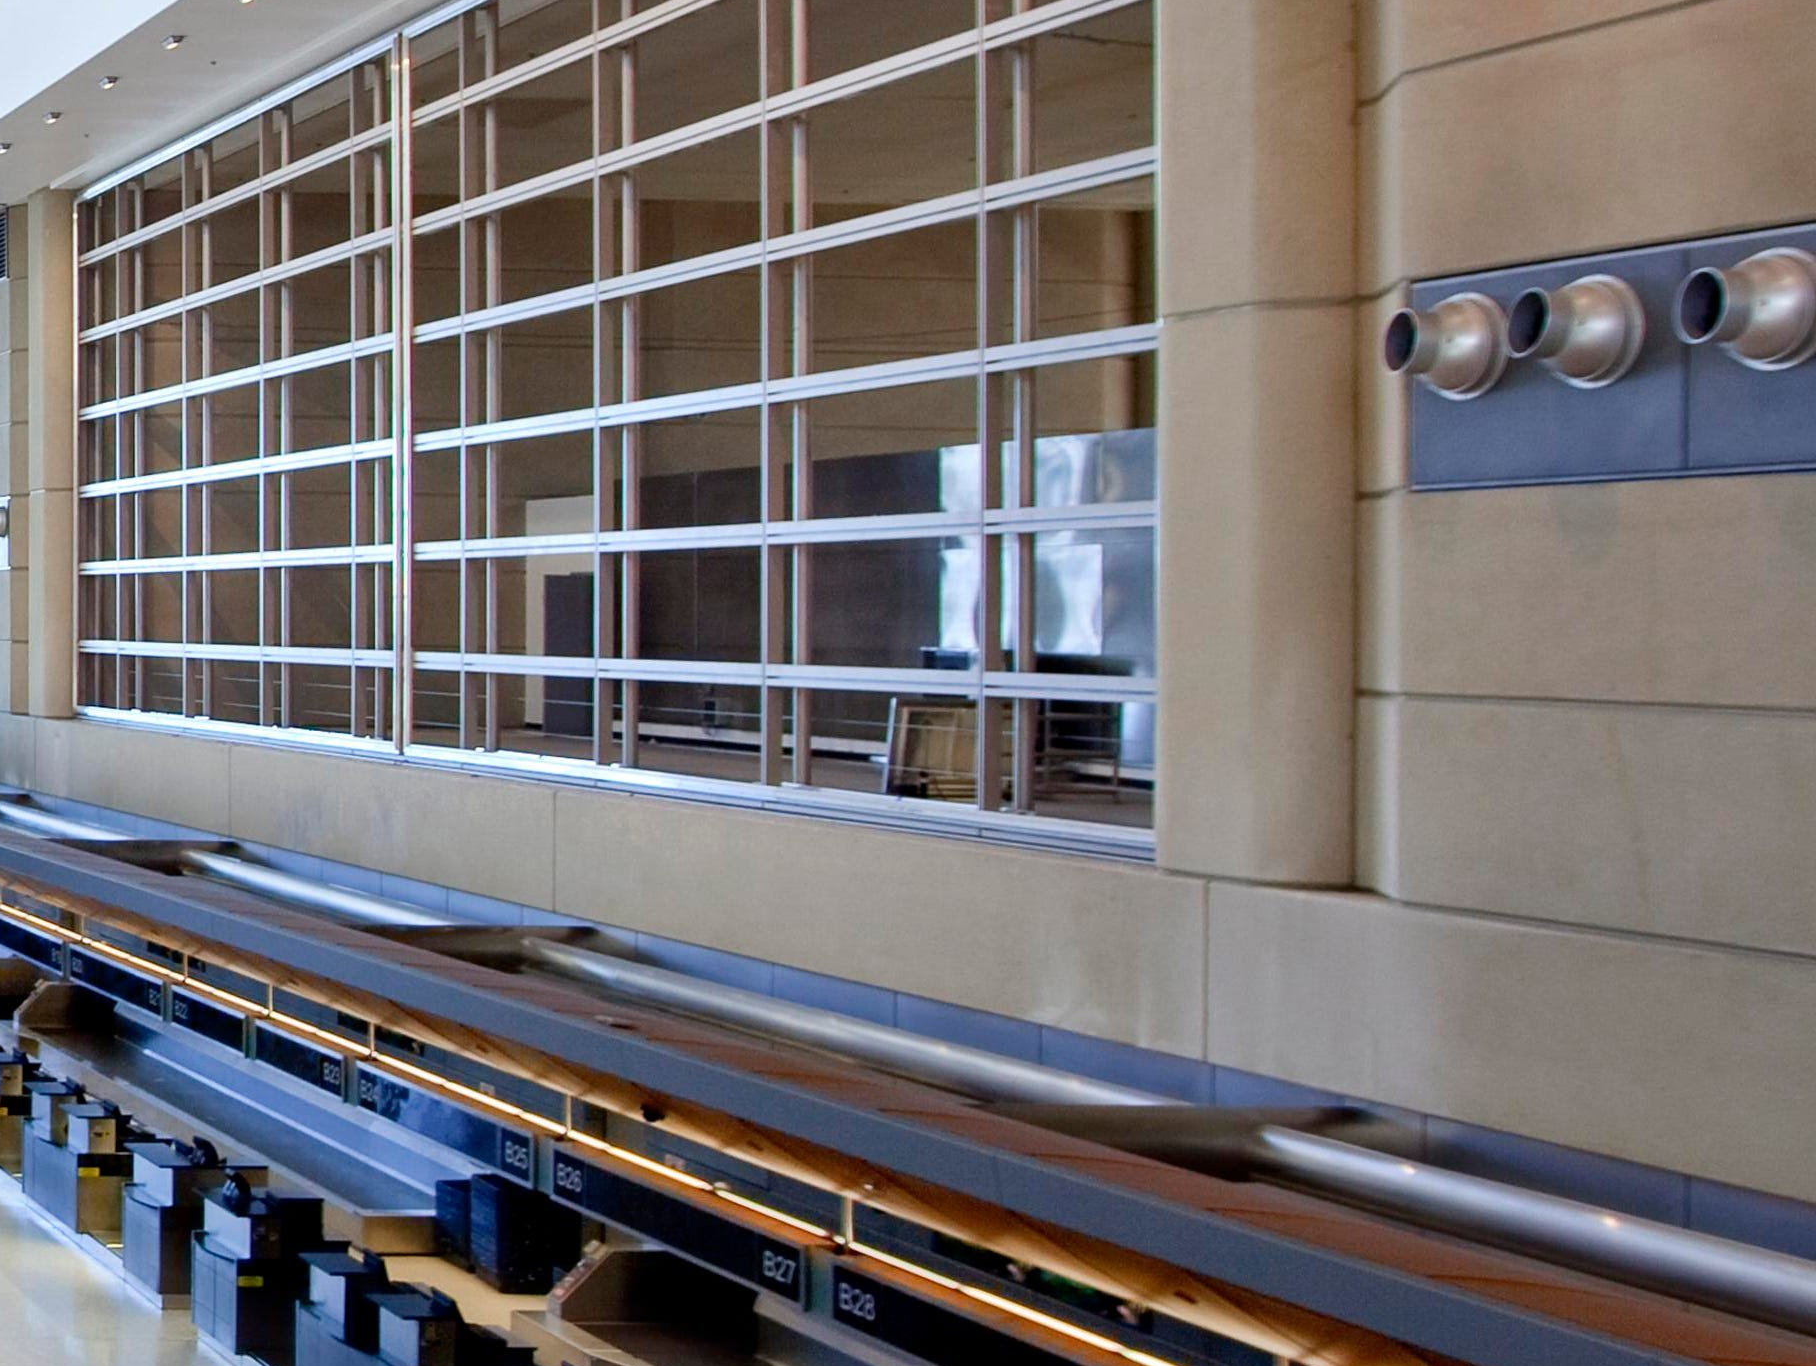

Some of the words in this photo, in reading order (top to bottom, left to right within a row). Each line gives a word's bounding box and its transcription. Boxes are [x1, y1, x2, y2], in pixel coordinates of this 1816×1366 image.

[504, 1140, 529, 1170] B25
[556, 1162, 583, 1193] B26
[762, 1250, 797, 1284] B27
[838, 1282, 876, 1321] B28
